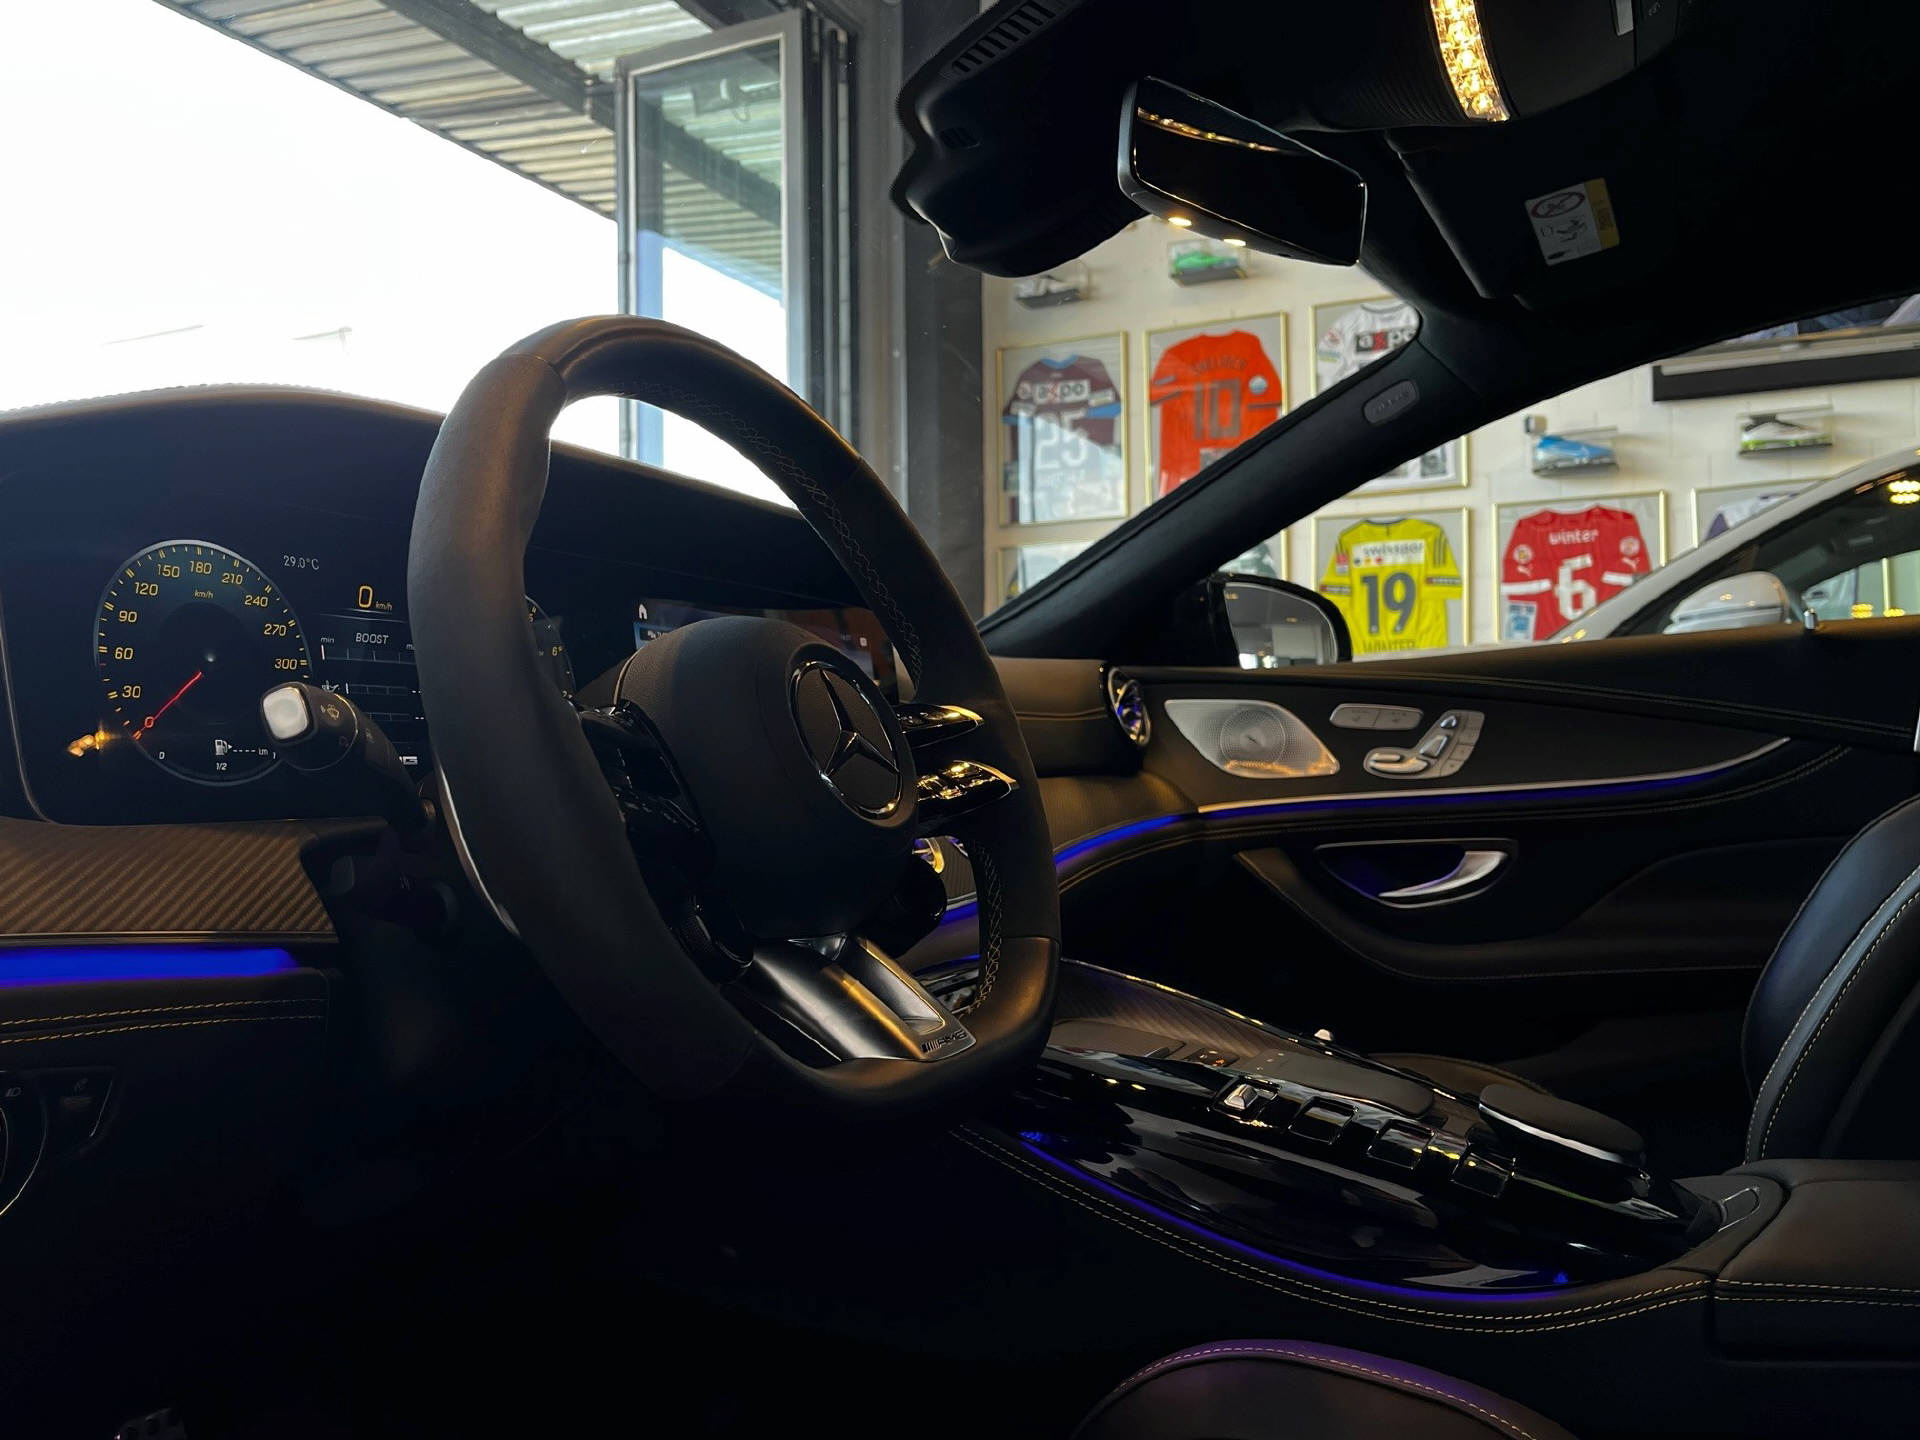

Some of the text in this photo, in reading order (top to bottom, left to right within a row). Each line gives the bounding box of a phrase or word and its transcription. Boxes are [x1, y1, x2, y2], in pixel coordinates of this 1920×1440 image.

[1037, 382, 1085, 401] axpo
[1194, 379, 1242, 442] 10
[1035, 410, 1088, 468] 25
[1549, 529, 1600, 545] winter
[157, 564, 181, 578] 150
[189, 560, 212, 575] 180
[221, 573, 243, 586] 210
[134, 582, 159, 597] 120
[194, 589, 214, 599] km/h
[1554, 553, 1598, 621] 6
[244, 595, 269, 608] 240
[358, 584, 374, 609] 0
[1361, 571, 1416, 635] 19
[118, 610, 138, 623] 90
[264, 623, 287, 637] 270
[320, 636, 335, 644] min
[355, 632, 389, 645] BOOST
[114, 646, 134, 660] 60
[274, 658, 298, 671] 300
[121, 685, 142, 699] 30
[144, 715, 154, 729] 0
